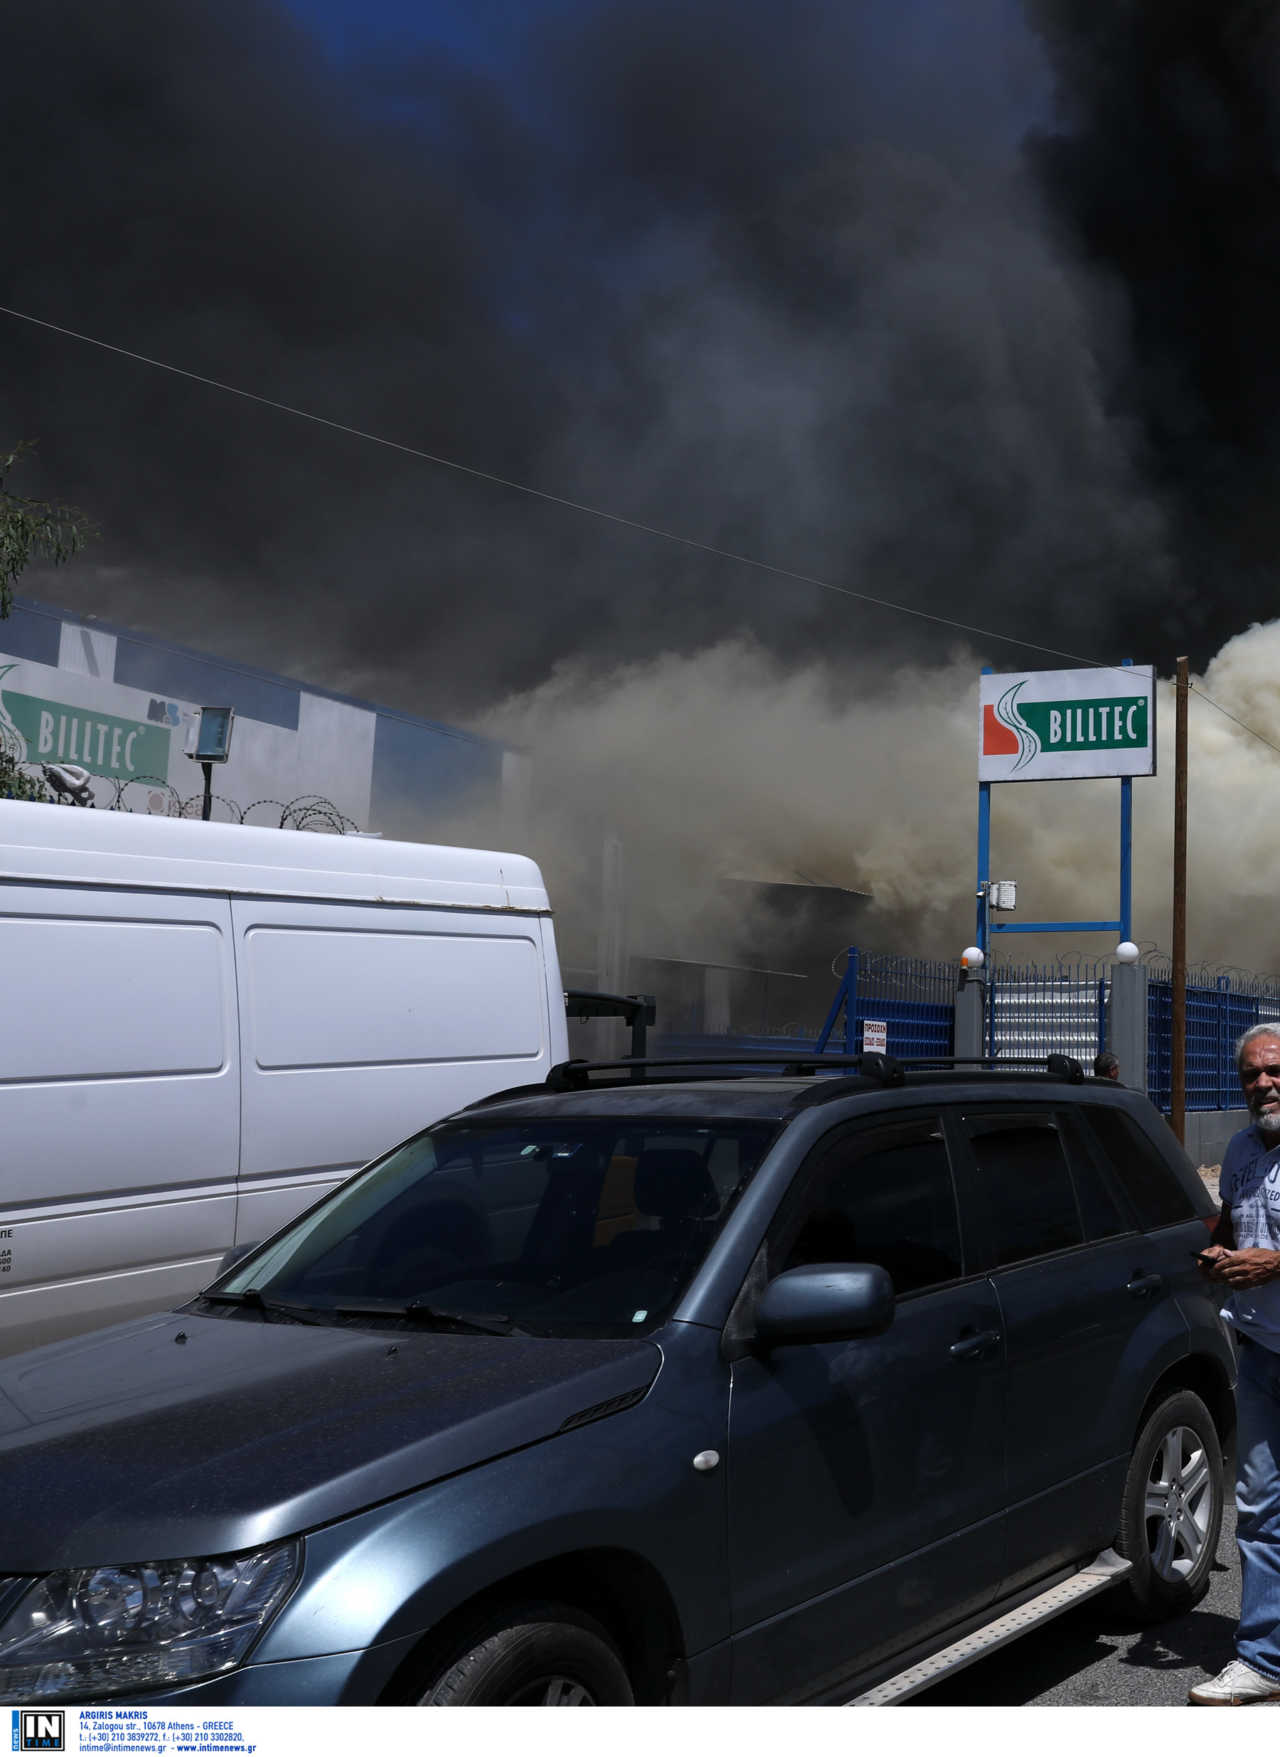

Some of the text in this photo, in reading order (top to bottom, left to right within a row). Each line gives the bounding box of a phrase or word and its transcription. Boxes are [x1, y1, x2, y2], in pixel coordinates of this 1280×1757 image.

[38, 710, 137, 772] BILLTEC
[1049, 705, 1137, 744] BILLTEC
[0, 1229, 13, 1238] ΠΕ
